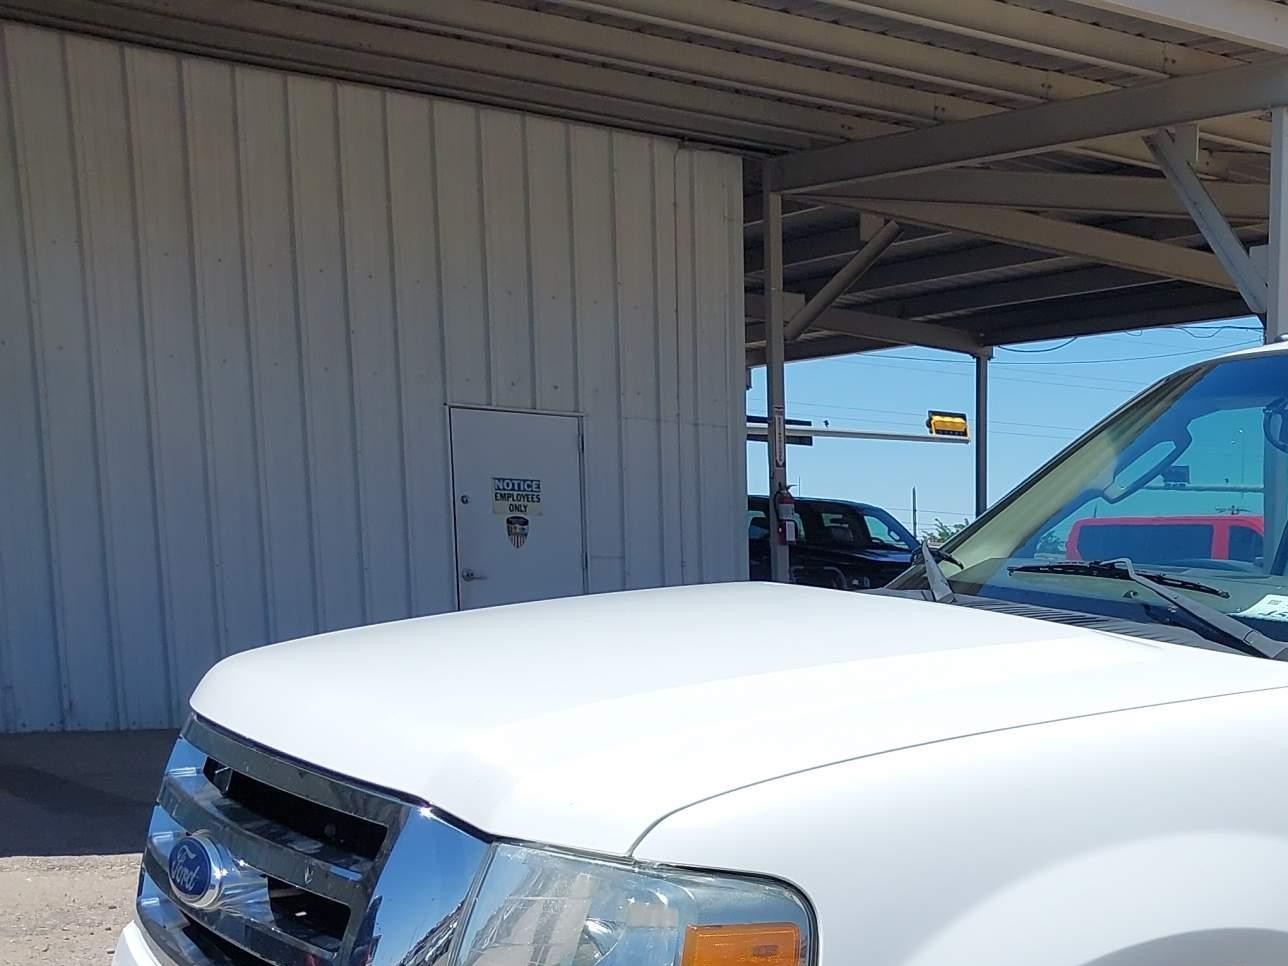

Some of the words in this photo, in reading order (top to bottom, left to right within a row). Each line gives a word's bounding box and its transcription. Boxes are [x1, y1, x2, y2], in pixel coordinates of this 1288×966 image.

[495, 479, 540, 491] NOTICE
[494, 491, 541, 503] EMPLOYEES
[508, 503, 528, 512] ONLY
[171, 844, 201, 891] Ford
